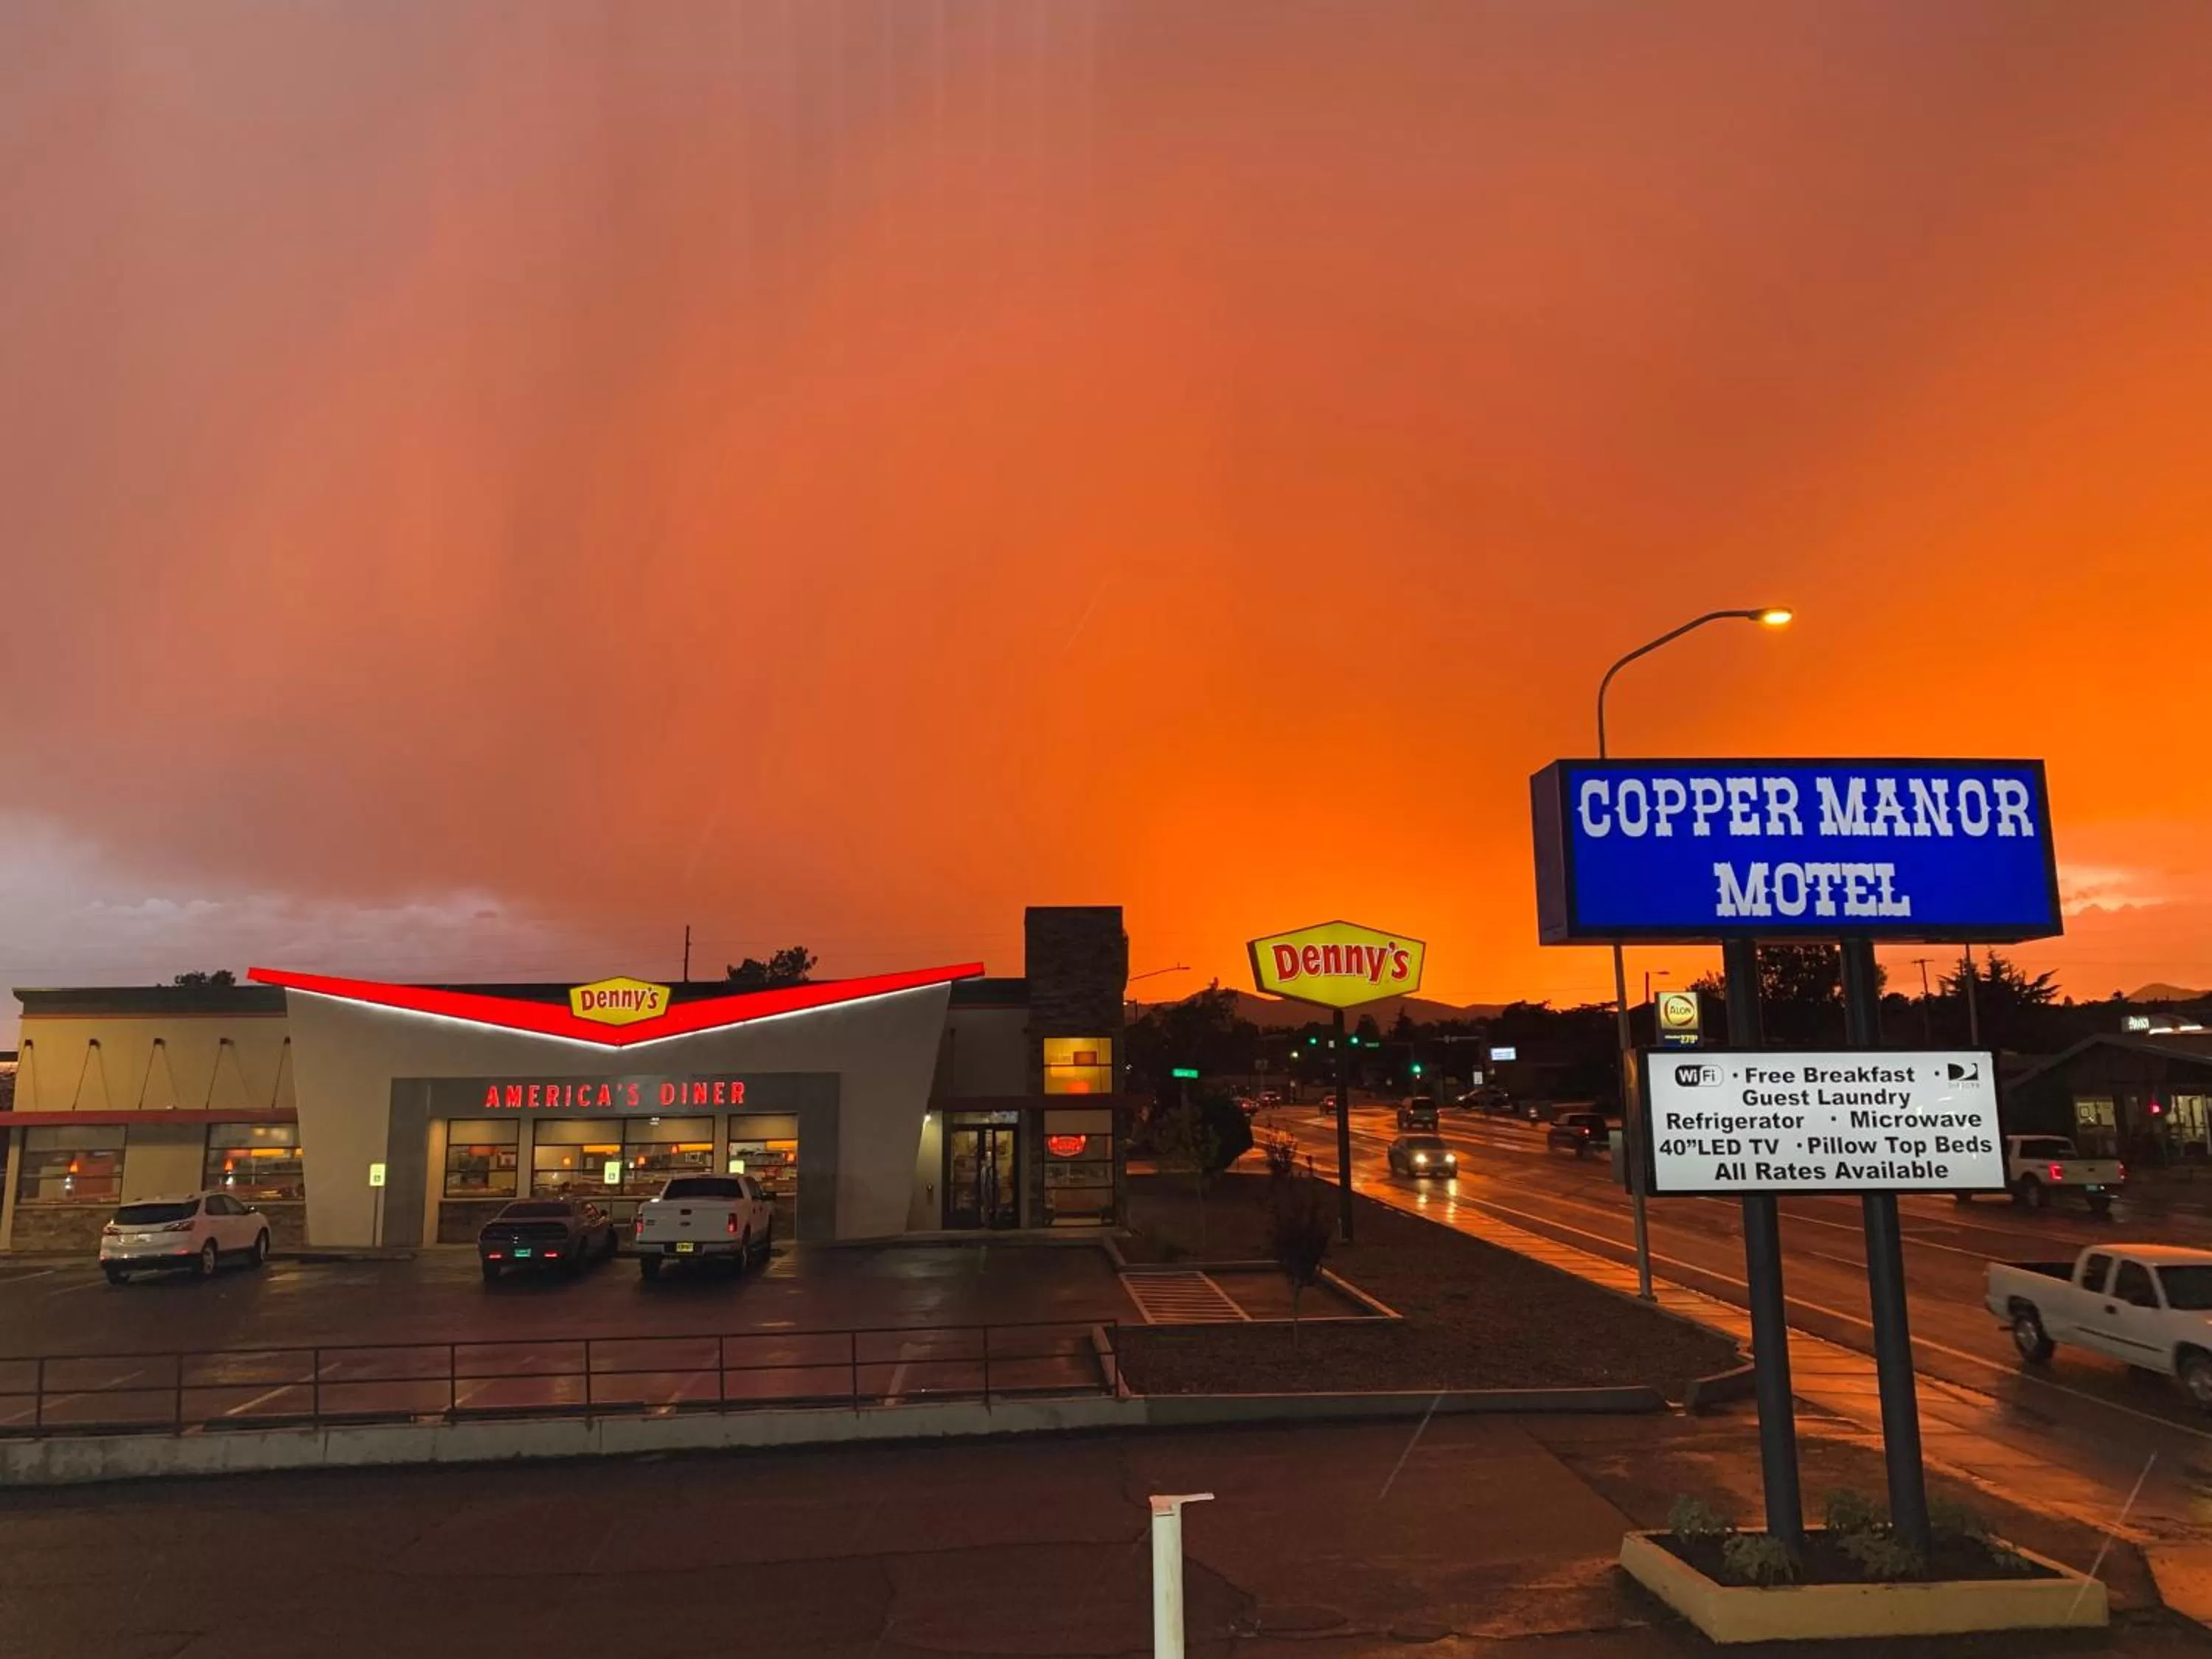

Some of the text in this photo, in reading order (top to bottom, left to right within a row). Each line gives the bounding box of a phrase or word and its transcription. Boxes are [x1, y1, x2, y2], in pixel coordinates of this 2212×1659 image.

[1578, 776, 2034, 838] COPPER MANOR
[1713, 861, 1911, 917] MOTEL
[1272, 941, 1410, 985] Denny's
[580, 987, 659, 1012] Denny's
[1745, 1067, 1795, 1083] Free
[1803, 1066, 1915, 1083] Breakfast
[485, 1080, 745, 1107] AMERICA'S DINER
[1742, 1088, 1910, 1110] Guest Laundry
[1666, 1110, 1982, 1134] Refrigerator Microwave
[1748, 1138, 1779, 1155] TV
[1807, 1136, 1877, 1155] Pillow
[1884, 1136, 1927, 1158] Top
[1935, 1135, 1992, 1153] Beds
[1714, 1160, 1949, 1180] All Rates Available
